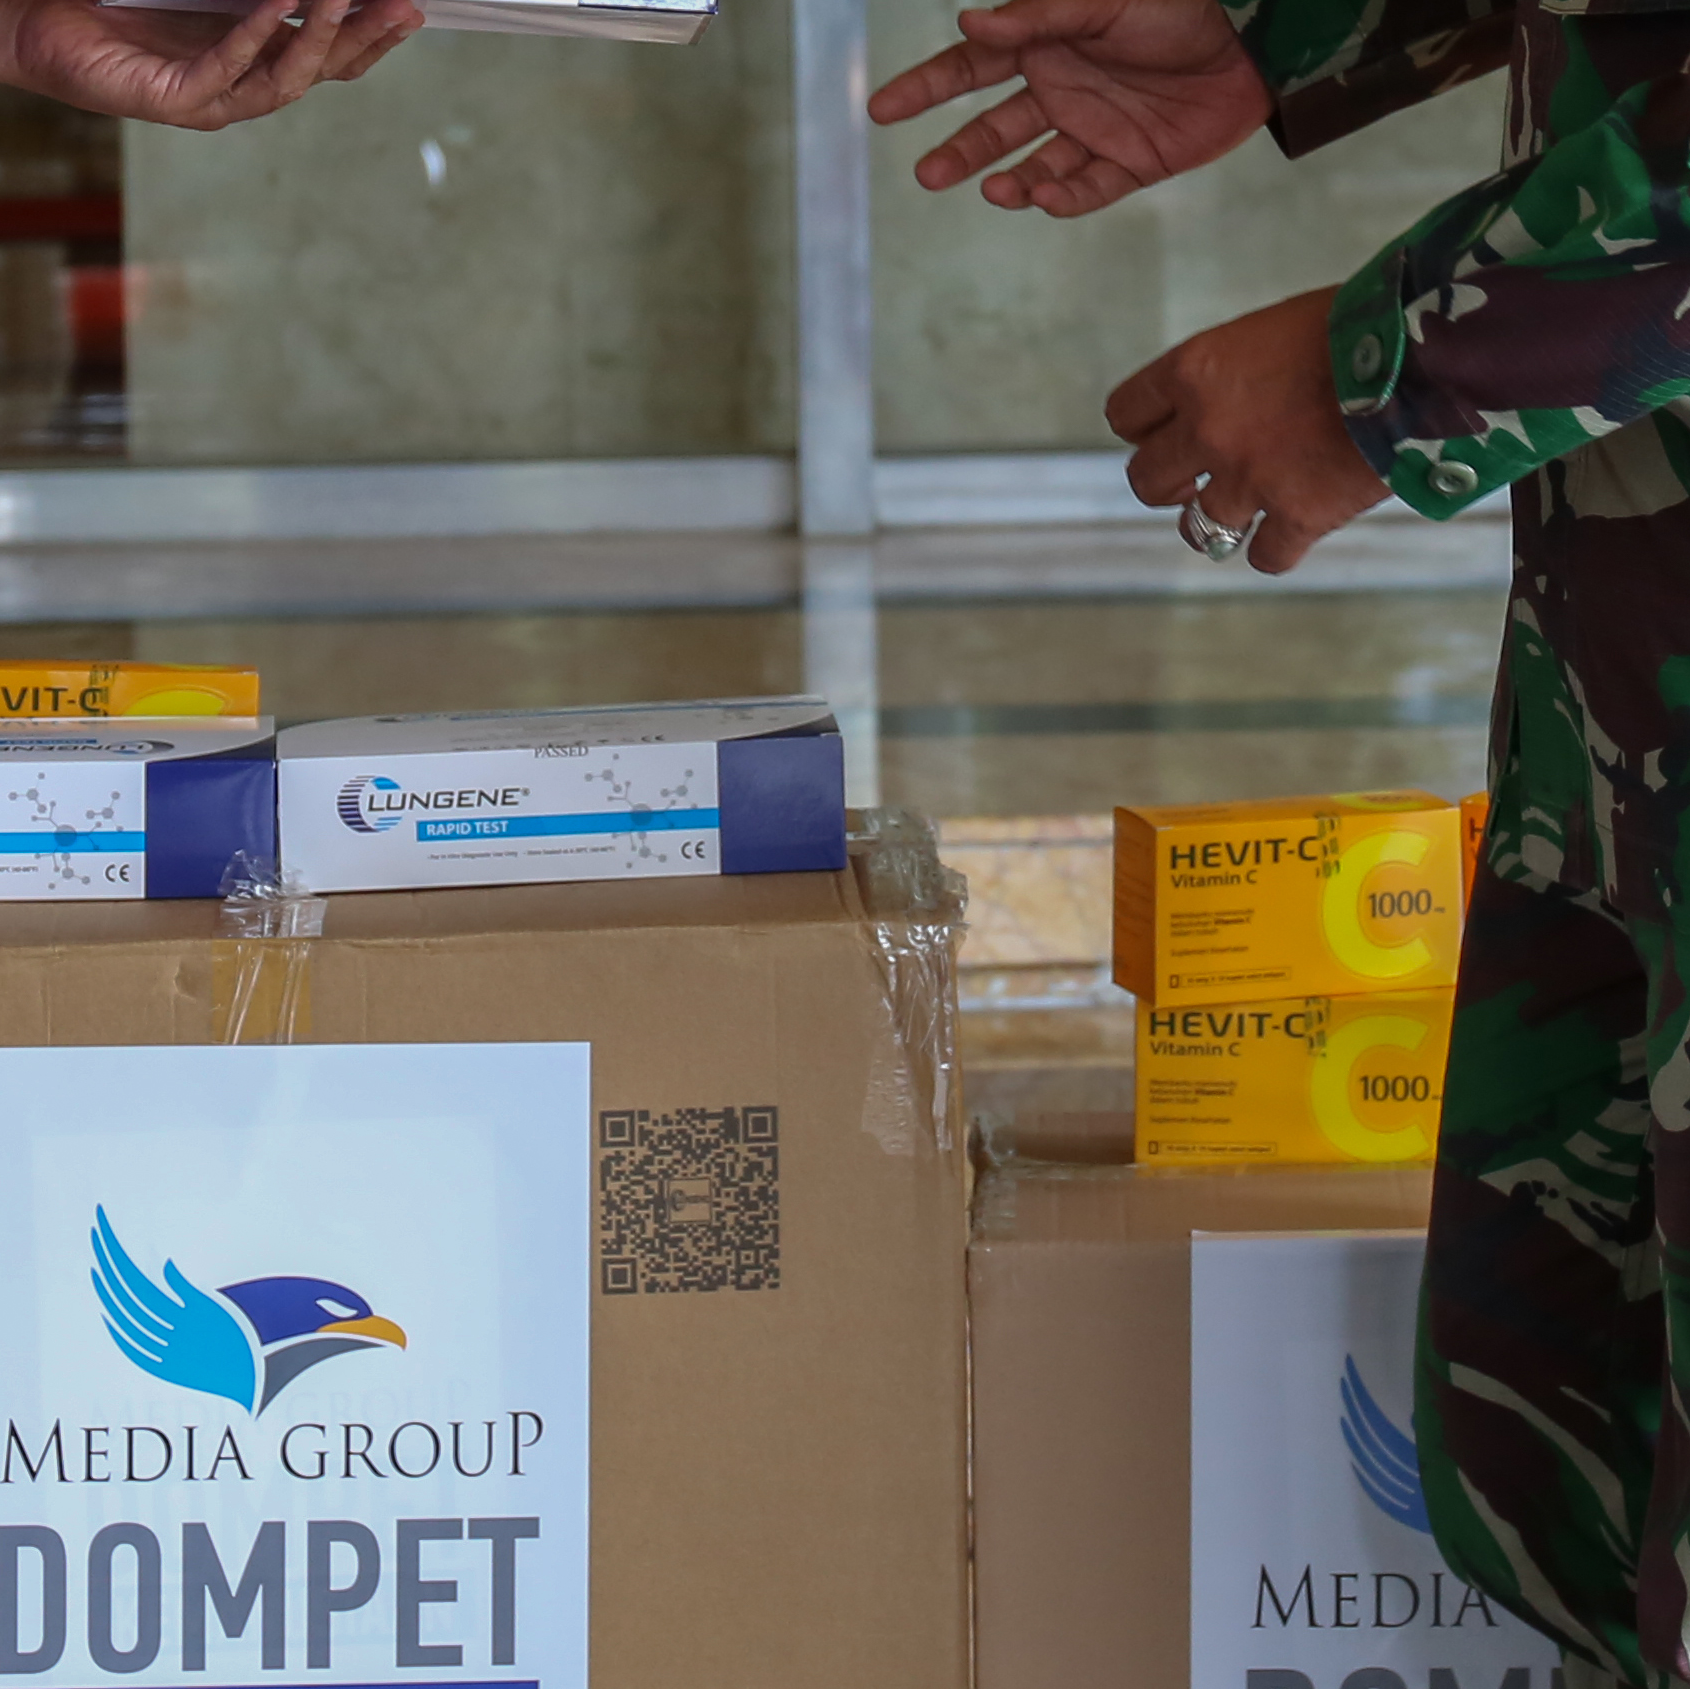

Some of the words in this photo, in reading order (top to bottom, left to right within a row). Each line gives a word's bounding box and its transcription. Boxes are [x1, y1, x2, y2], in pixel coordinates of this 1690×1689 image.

[534, 744, 589, 759] PASSED
[426, 821, 472, 837] RAPID
[474, 819, 509, 835] TEST
[1170, 836, 1319, 869] HEVIT-C
[1171, 873, 1242, 889] Vitamin
[1246, 870, 1258, 885] C
[1368, 889, 1433, 919] 1000
[1149, 1011, 1307, 1039] HEVIT-C
[1150, 1042, 1223, 1057] Vitamin
[1228, 1042, 1241, 1057] C
[1360, 1074, 1431, 1103] 1000
[280, 1410, 545, 1480] GROUP
